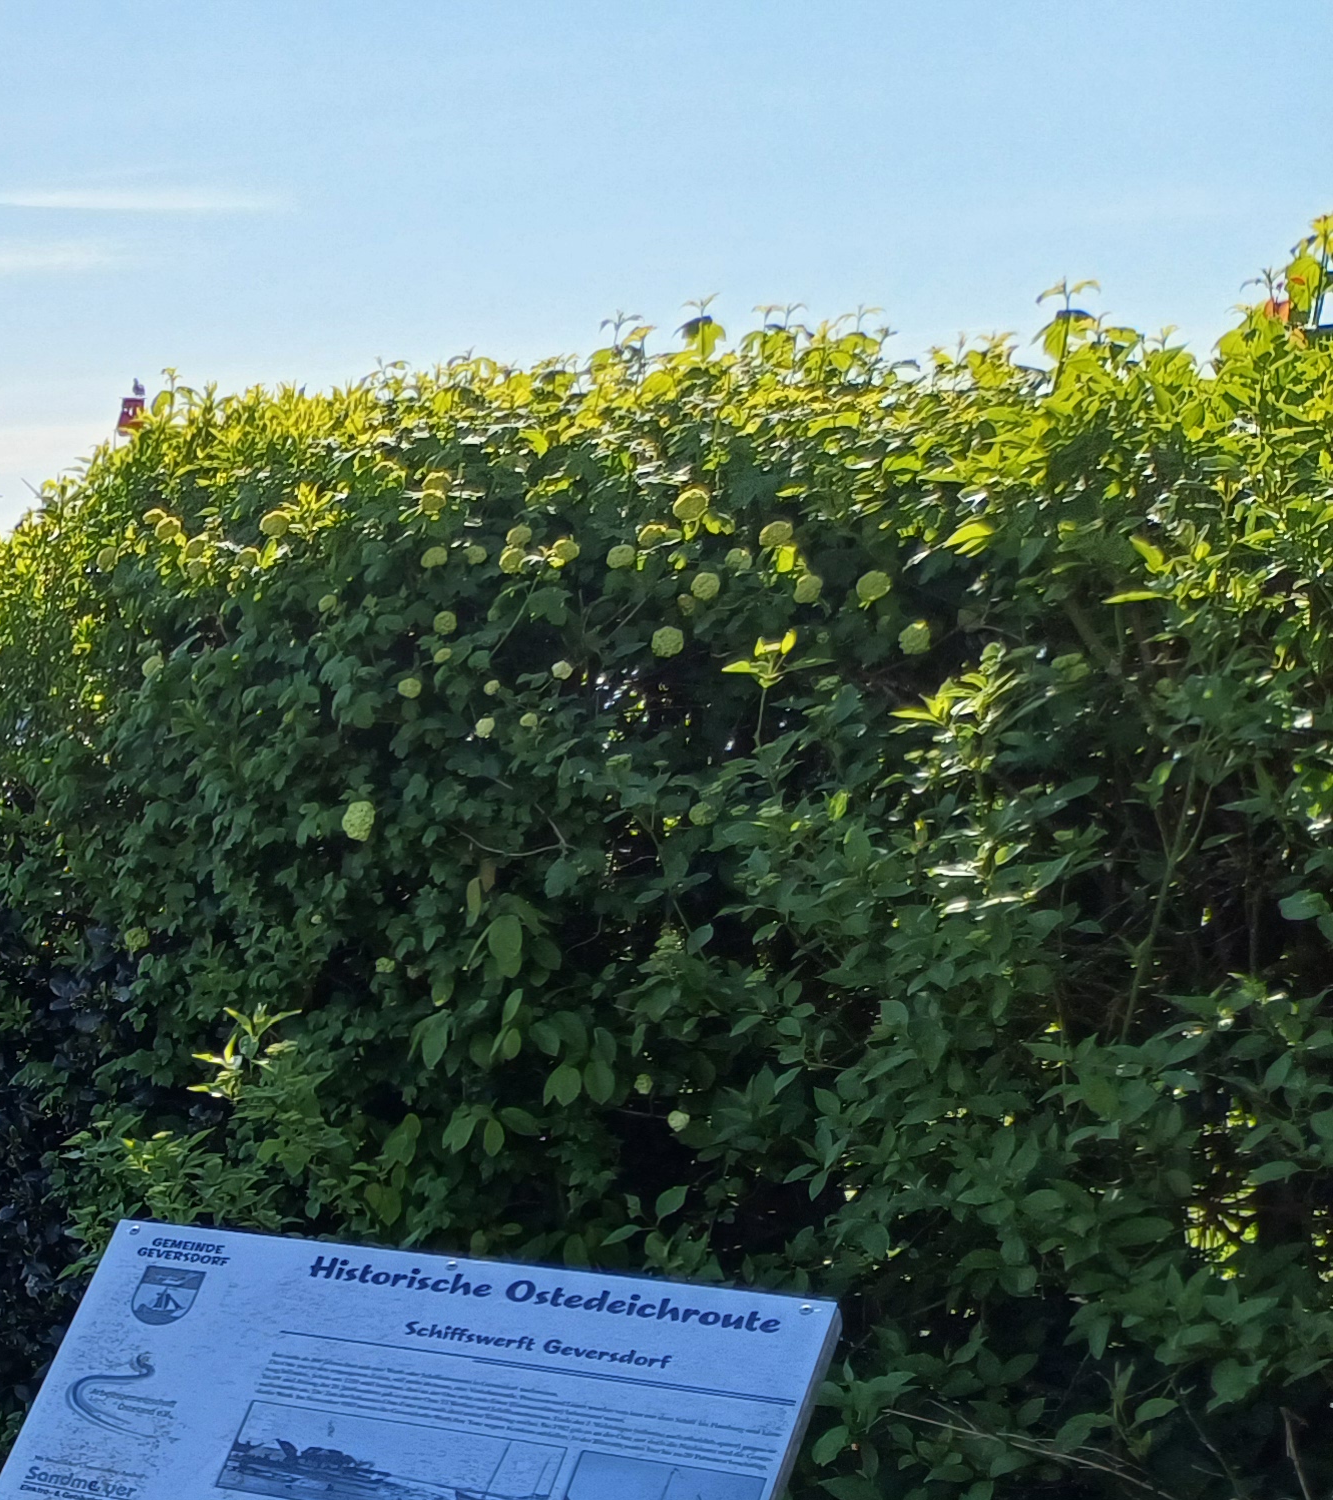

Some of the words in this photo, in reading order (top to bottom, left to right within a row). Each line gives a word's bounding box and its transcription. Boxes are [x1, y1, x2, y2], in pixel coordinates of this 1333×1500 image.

[138, 1247, 231, 1266] GEVERSDORF
[152, 1237, 225, 1254] GEMEINDE
[309, 1255, 493, 1297] Historische
[505, 1280, 781, 1334] Ostedeichroute
[405, 1321, 536, 1352] Schiffswerft
[543, 1339, 672, 1369] Geversdorf
